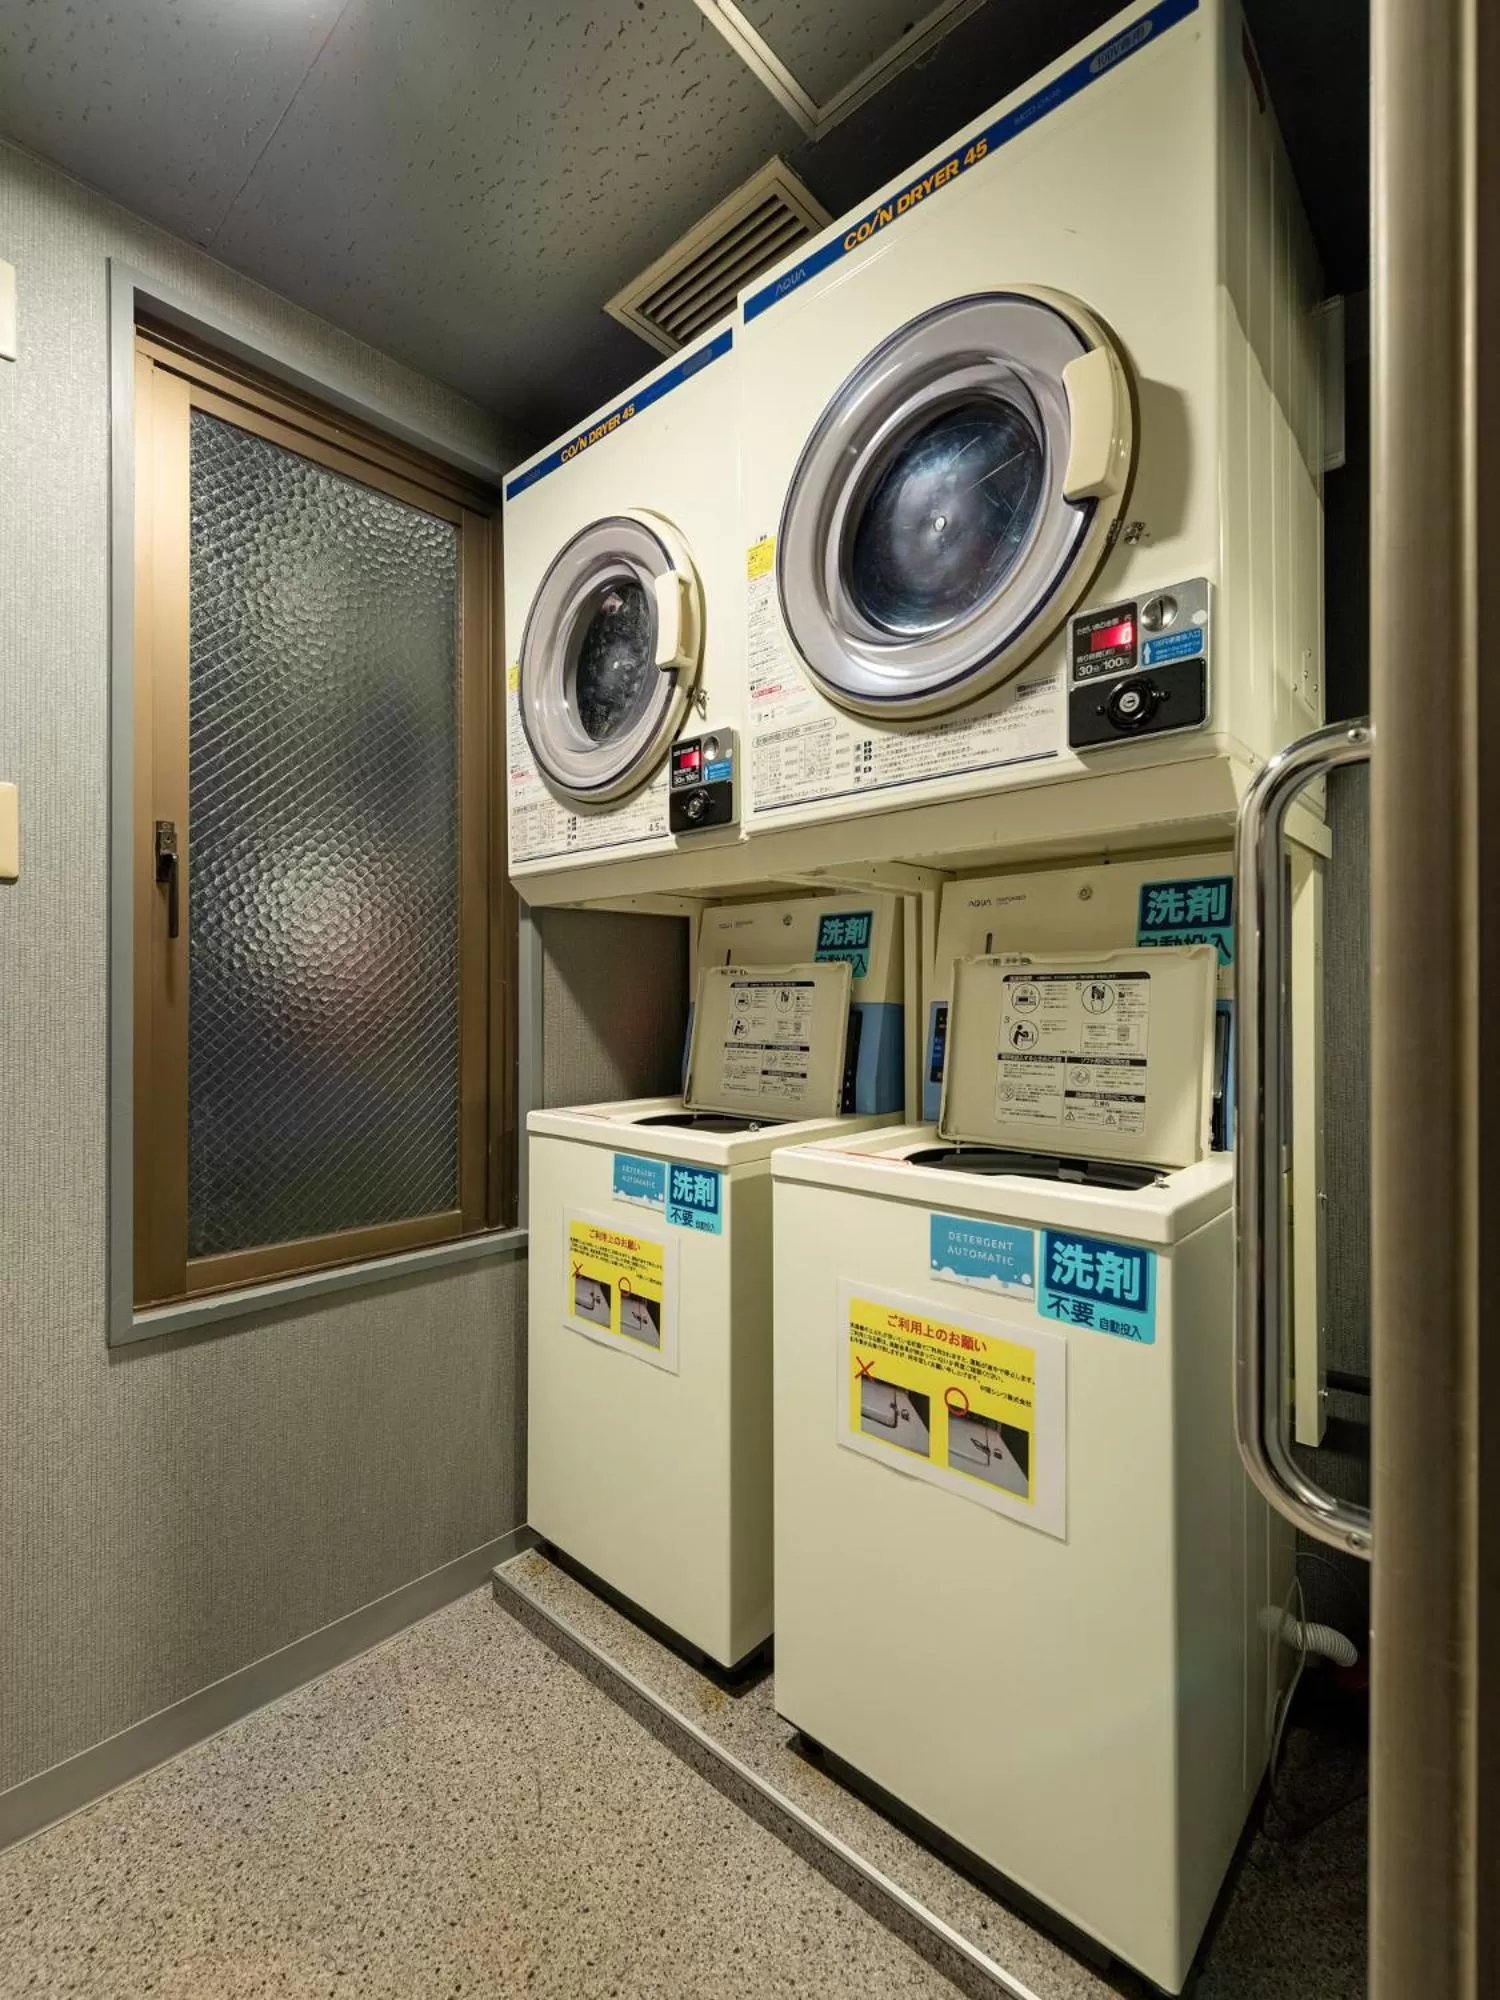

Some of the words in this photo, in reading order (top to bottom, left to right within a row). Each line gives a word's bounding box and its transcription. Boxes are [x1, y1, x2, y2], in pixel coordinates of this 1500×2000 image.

[843, 204, 893, 251] COIN
[897, 160, 959, 214] DRYER
[964, 138, 988, 165] 45
[775, 267, 807, 296] AQUA
[588, 415, 620, 445] DRYER
[623, 403, 636, 420] 45
[1146, 884, 1227, 925] 洗剤
[821, 916, 868, 946] 洗剤
[621, 1164, 656, 1178] DETERGENT
[621, 1174, 656, 1189] AUTOMATIC
[672, 1169, 715, 1208] 洗剤
[670, 1206, 693, 1228] 不要
[947, 1245, 1015, 1266] AUTOMATIC
[948, 1231, 1014, 1251] DETERGENT
[1051, 1240, 1141, 1302] 洗剤
[887, 1313, 987, 1352] ご利用上のお願い
[1047, 1292, 1095, 1328] 不要
[1099, 1317, 1142, 1341] 自動投入
